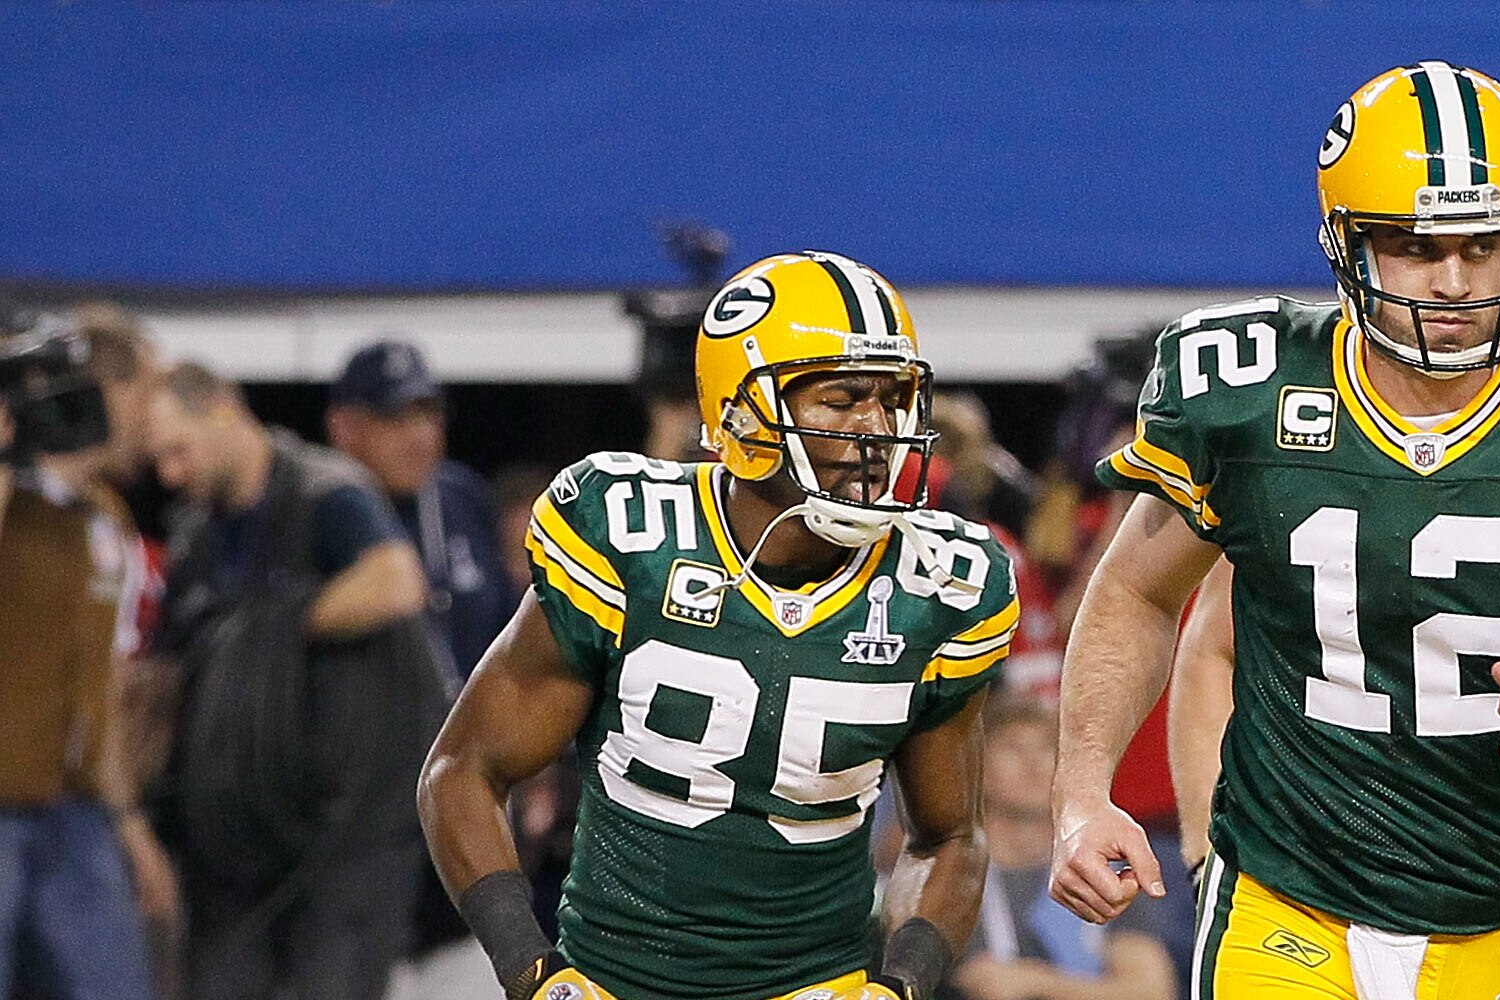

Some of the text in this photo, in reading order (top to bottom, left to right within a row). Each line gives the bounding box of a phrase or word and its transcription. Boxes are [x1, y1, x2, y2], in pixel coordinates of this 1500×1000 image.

[1437, 190, 1480, 203] PACKERS
[703, 277, 773, 336] G
[1179, 297, 1279, 400] 12
[1282, 391, 1334, 435] C
[585, 451, 699, 554] 85
[840, 639, 907, 665] XLV
[597, 638, 916, 845] 85
